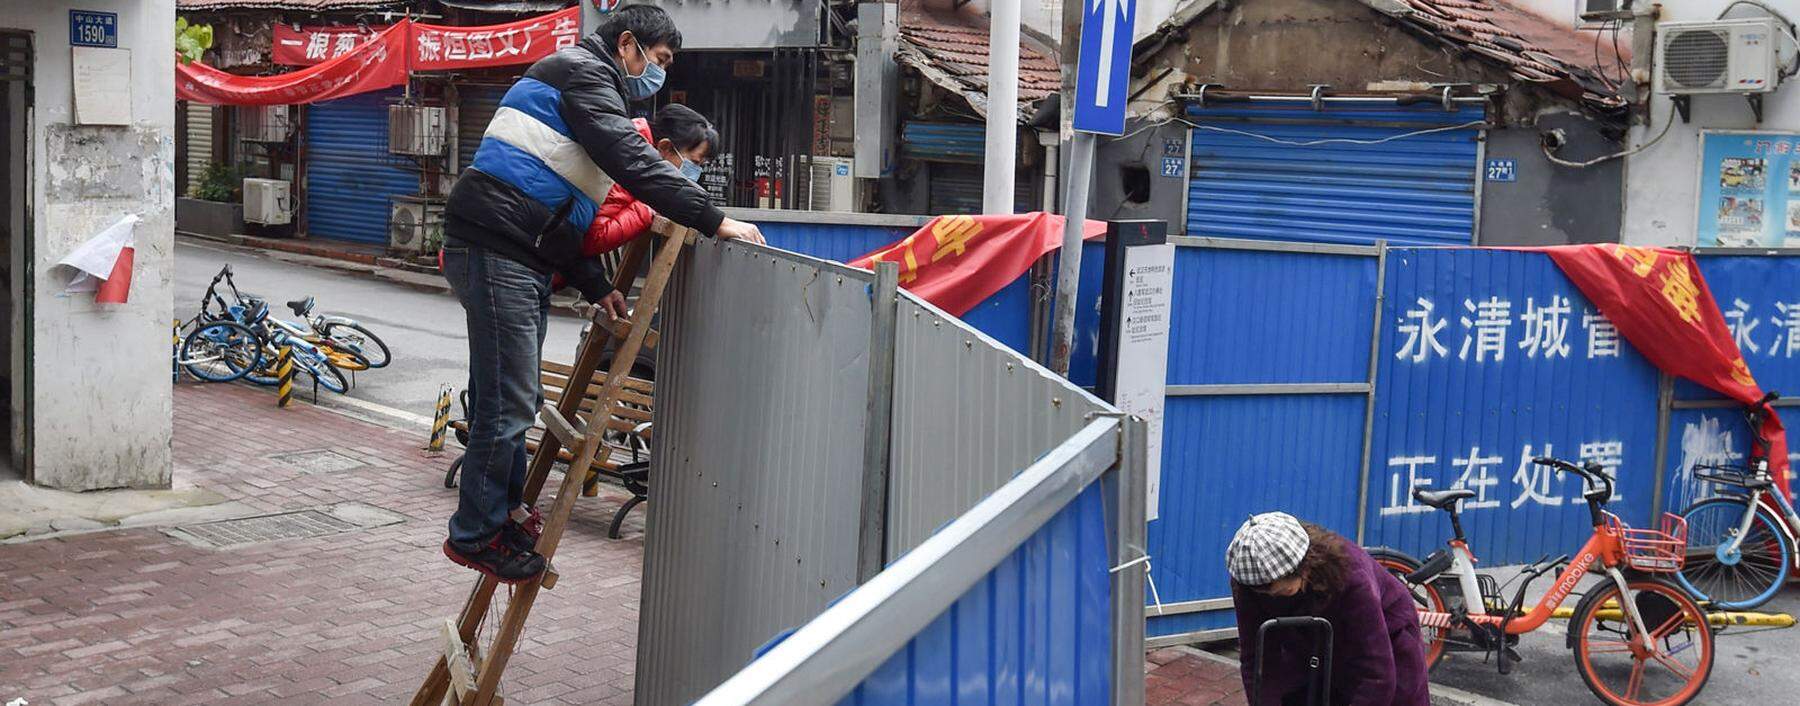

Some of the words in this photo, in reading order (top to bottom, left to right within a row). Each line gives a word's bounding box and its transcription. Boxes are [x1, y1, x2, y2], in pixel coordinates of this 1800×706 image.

[75, 14, 113, 25] 中山大道
[78, 24, 105, 43] 1590
[280, 31, 388, 62] 一根葱
[417, 17, 579, 62] 振恒图文广告
[1165, 165, 1178, 175] 27
[1379, 441, 1623, 516] 正在处置
[1559, 552, 1594, 595] mobike
